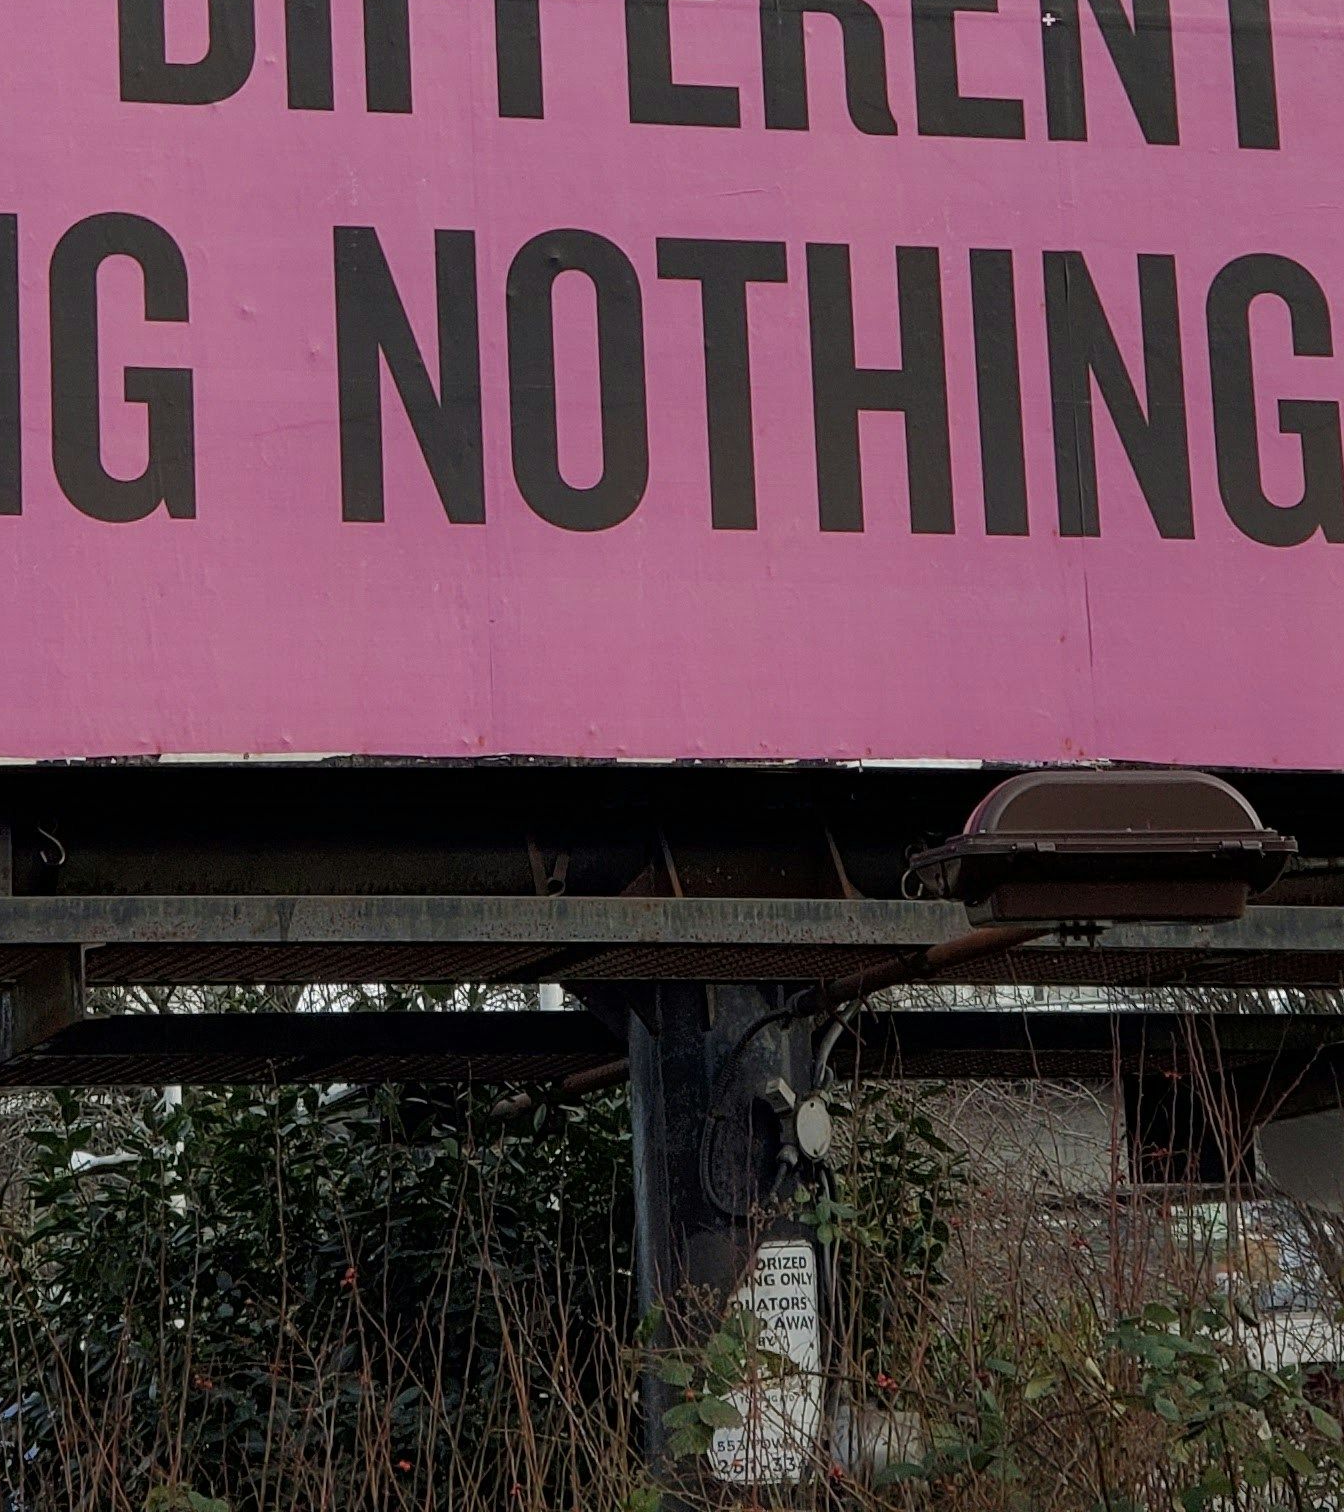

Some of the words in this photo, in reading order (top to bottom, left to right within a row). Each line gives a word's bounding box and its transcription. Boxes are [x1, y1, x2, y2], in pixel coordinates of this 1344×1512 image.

[756, 1256, 807, 1271] ORIZED
[780, 1272, 813, 1286] ONLY
[774, 1316, 815, 1330] AWAY
